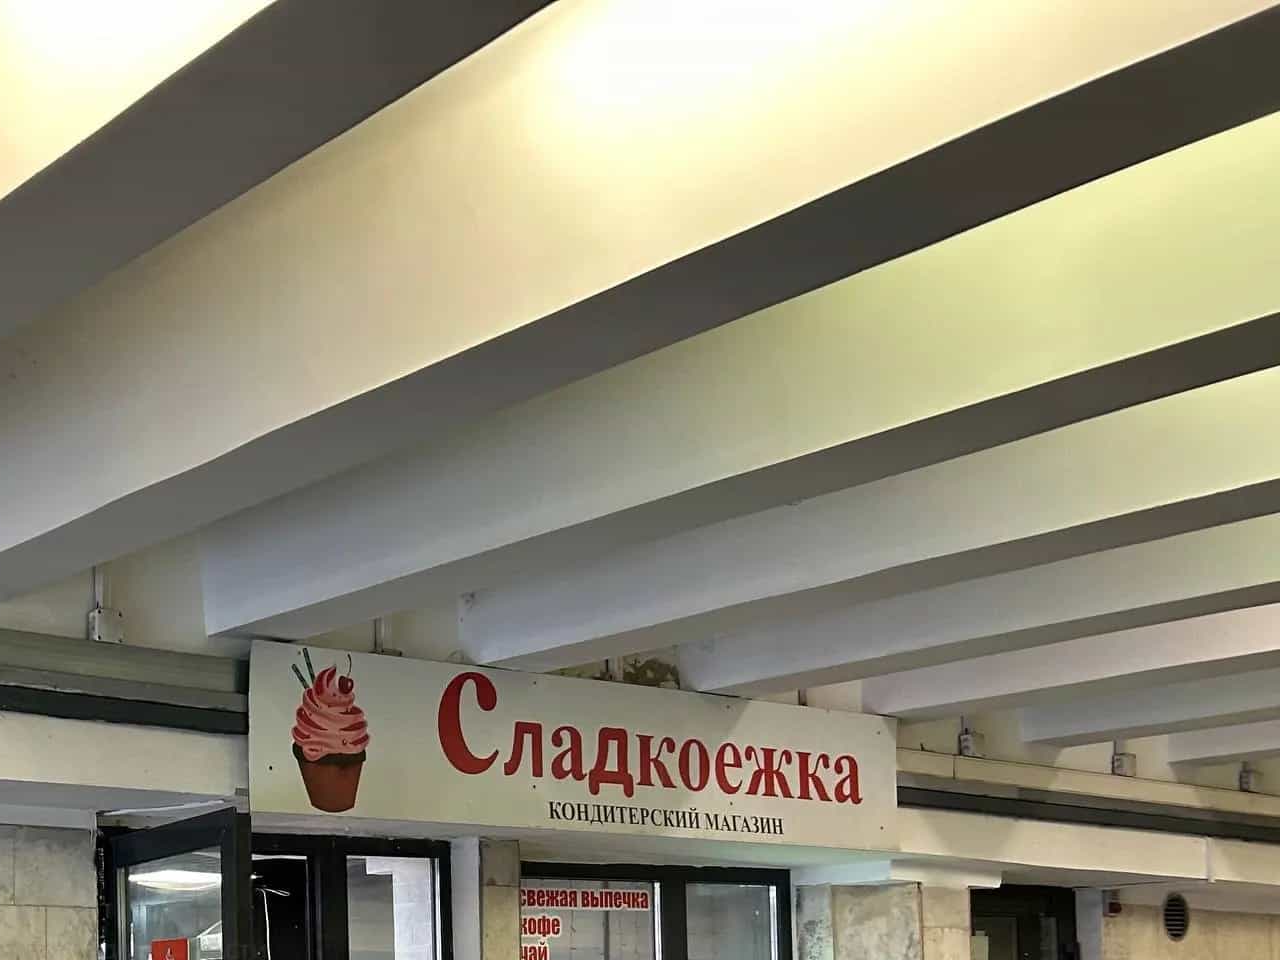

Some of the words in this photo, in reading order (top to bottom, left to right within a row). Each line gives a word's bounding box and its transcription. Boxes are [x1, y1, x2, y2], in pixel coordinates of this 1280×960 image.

[437, 671, 864, 805] Сладкоежка
[548, 800, 700, 829] КОНДИТЕРСКИЙ
[705, 812, 784, 835] МАГАЗИН
[520, 889, 577, 907] свежая
[581, 890, 649, 909] выпечка
